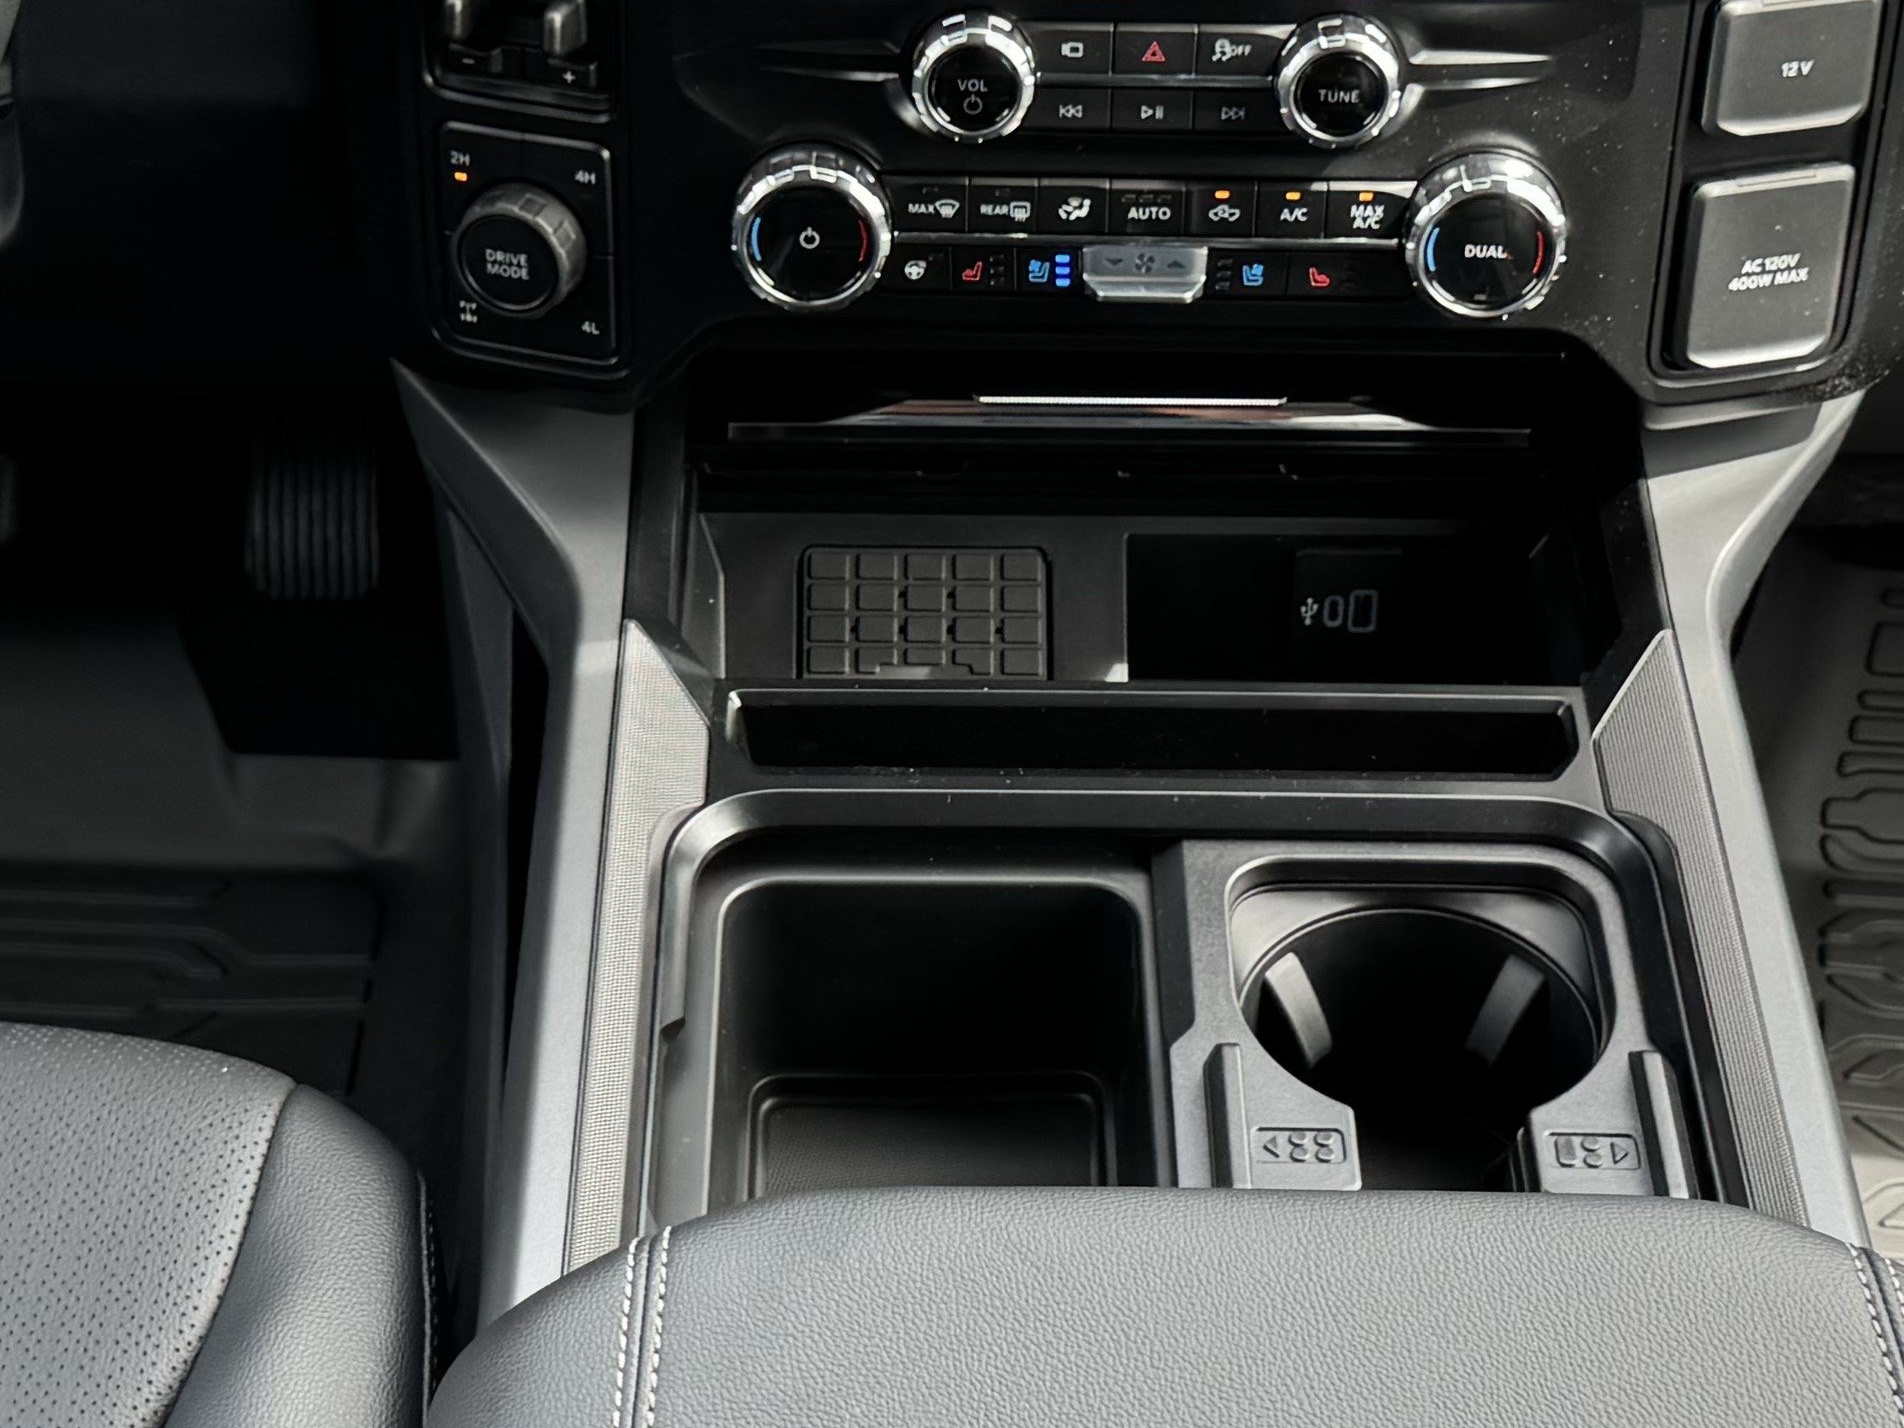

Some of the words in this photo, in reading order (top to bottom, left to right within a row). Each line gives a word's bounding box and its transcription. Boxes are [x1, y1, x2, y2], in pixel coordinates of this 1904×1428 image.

[1231, 44, 1251, 58] OFF
[957, 78, 988, 93] VOL
[1318, 88, 1360, 103] TUNE
[450, 150, 469, 167] 2H
[575, 170, 596, 185] 4H
[908, 203, 935, 214] MAX
[980, 204, 1009, 215] REAR
[1127, 206, 1171, 220] AUTO
[1280, 208, 1308, 222] A/C
[1350, 205, 1384, 218] MAX
[1352, 216, 1381, 230] A/C
[485, 248, 528, 266] DRIVE
[1464, 243, 1508, 259] DUAL
[1741, 258, 1763, 274] AC
[1765, 253, 1800, 270] 120V
[486, 263, 530, 281] MODE
[1774, 267, 1809, 285] MAX
